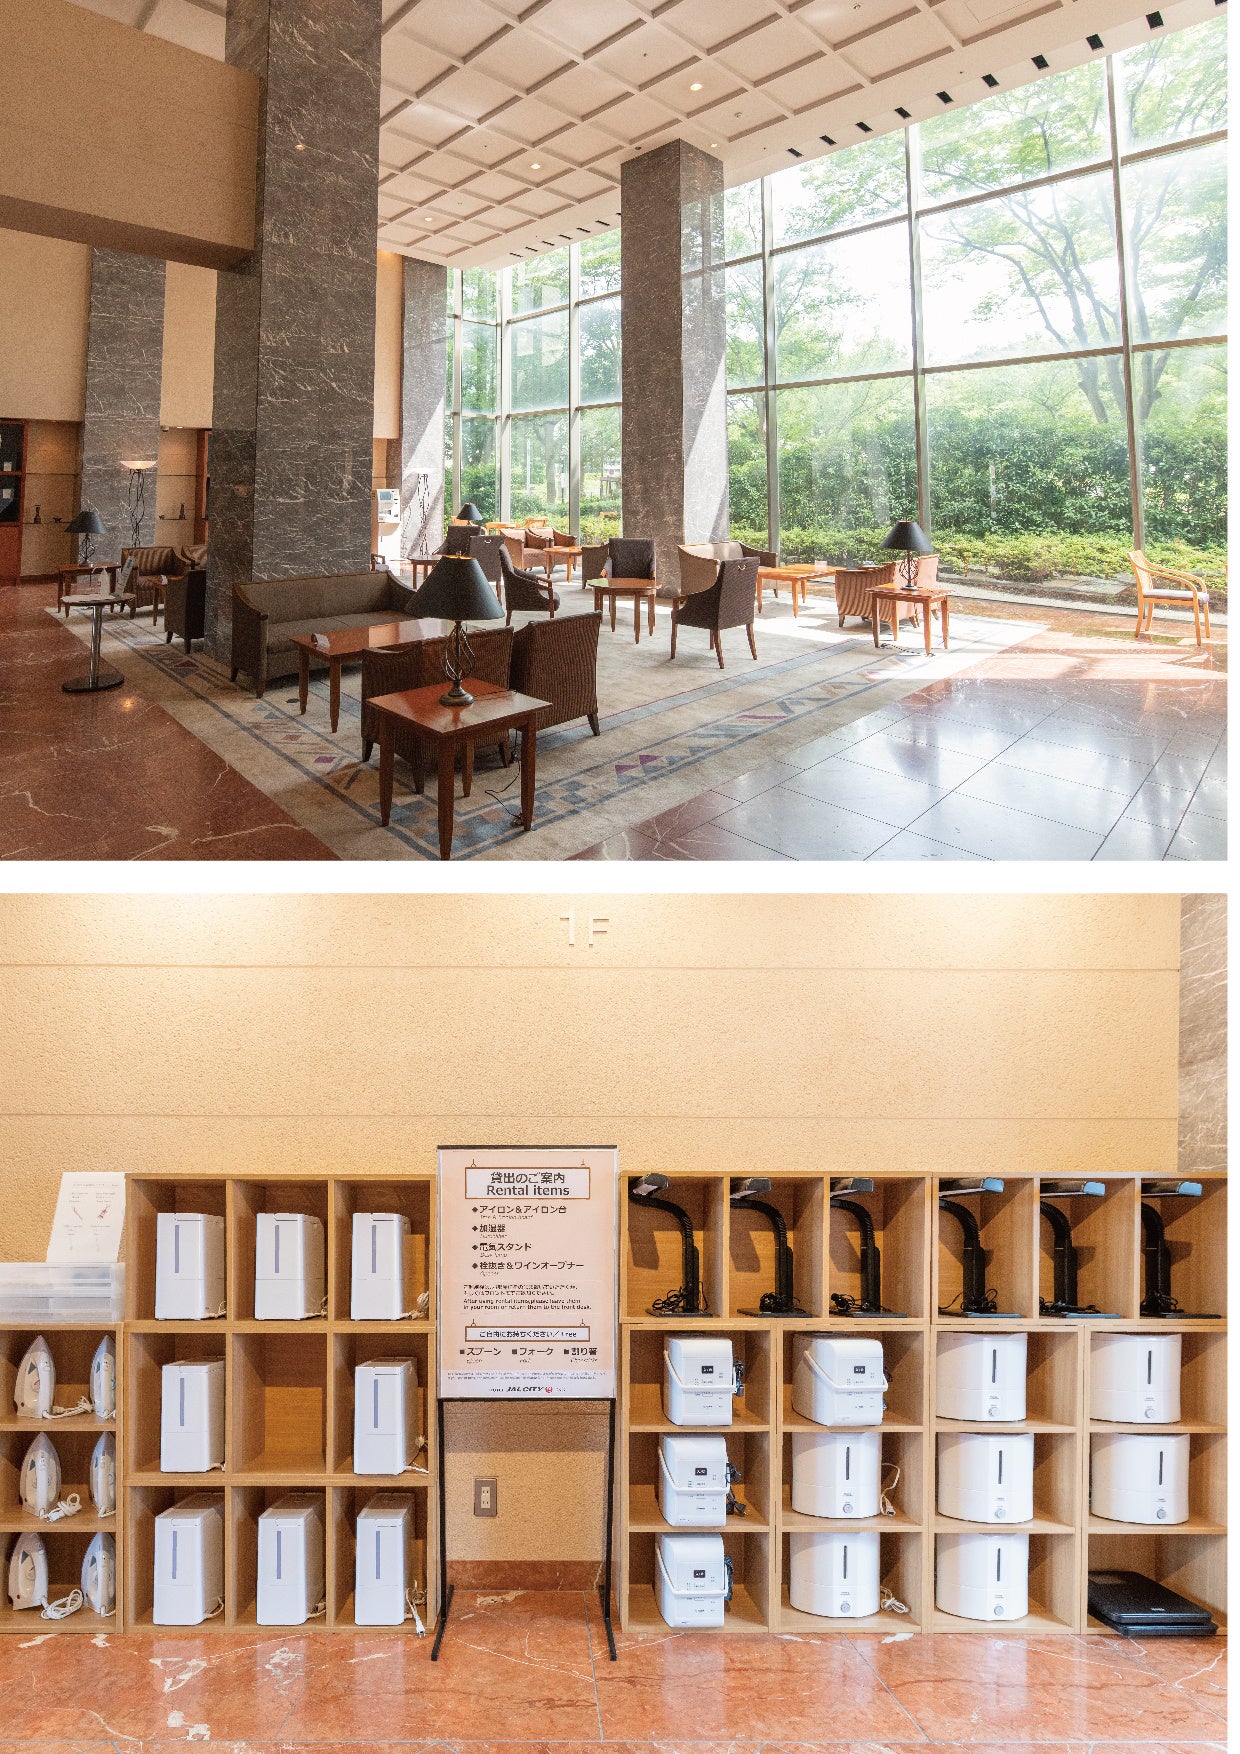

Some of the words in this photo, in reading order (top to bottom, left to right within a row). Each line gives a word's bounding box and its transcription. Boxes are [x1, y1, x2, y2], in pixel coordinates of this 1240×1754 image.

[559, 911, 610, 947] 1F
[490, 1171, 566, 1184] 貸出のご案内
[486, 1185, 529, 1196] Rental
[533, 1185, 570, 1196] items
[479, 1224, 506, 1233] 加湿器
[479, 1243, 532, 1251] 電気スタンド
[466, 1347, 502, 1356] スプーン
[519, 1347, 554, 1356] フォーク
[571, 1347, 598, 1356] 割り箸
